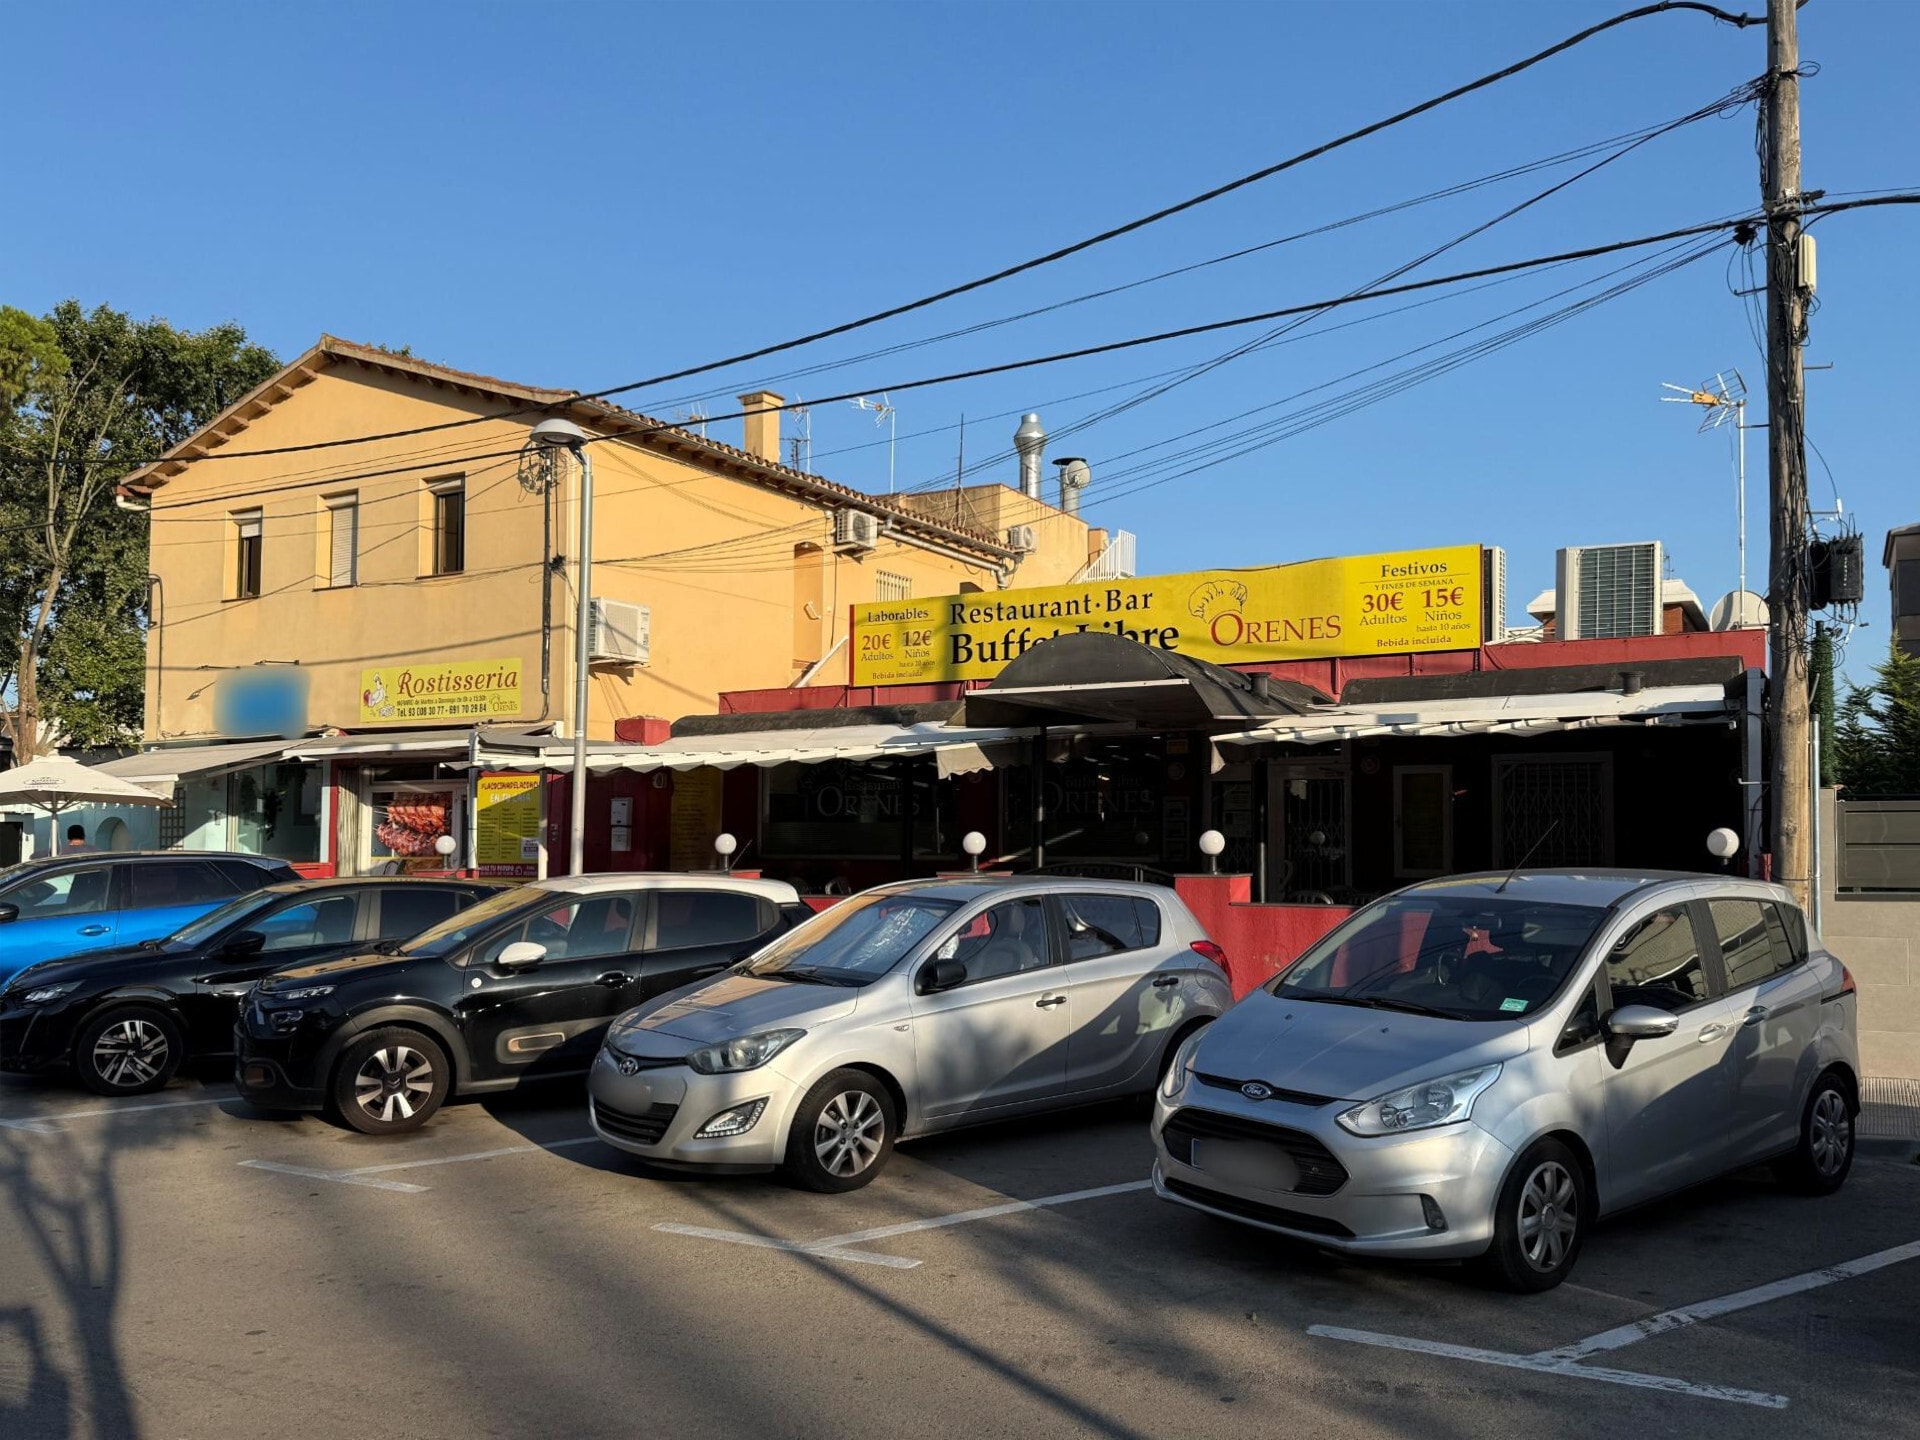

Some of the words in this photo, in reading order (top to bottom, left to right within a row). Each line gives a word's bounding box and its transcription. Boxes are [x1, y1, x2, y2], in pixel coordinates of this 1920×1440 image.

[1381, 561, 1447, 577] Festivos
[1418, 579, 1454, 587] SEMANA
[950, 593, 1092, 625] Restaurant
[1105, 589, 1153, 612] Bar
[1362, 592, 1404, 613] 30€
[1422, 587, 1464, 608] 15€
[868, 608, 929, 622] Laborables
[1359, 614, 1407, 626] Adultos
[1425, 610, 1462, 621] Niños
[1417, 624, 1438, 632] hasta
[1440, 623, 1449, 631] 10
[1451, 622, 1470, 630] años
[861, 633, 892, 651] 20€
[902, 630, 932, 647] 12€
[949, 627, 1060, 665] Buff
[1377, 637, 1409, 647] Bebida
[1412, 636, 1451, 646] incluida
[861, 651, 894, 661] Adultos
[905, 648, 930, 659] Niños
[396, 665, 518, 698] Rostisseria
[872, 671, 895, 680] Bebida
[437, 705, 445, 715] 77
